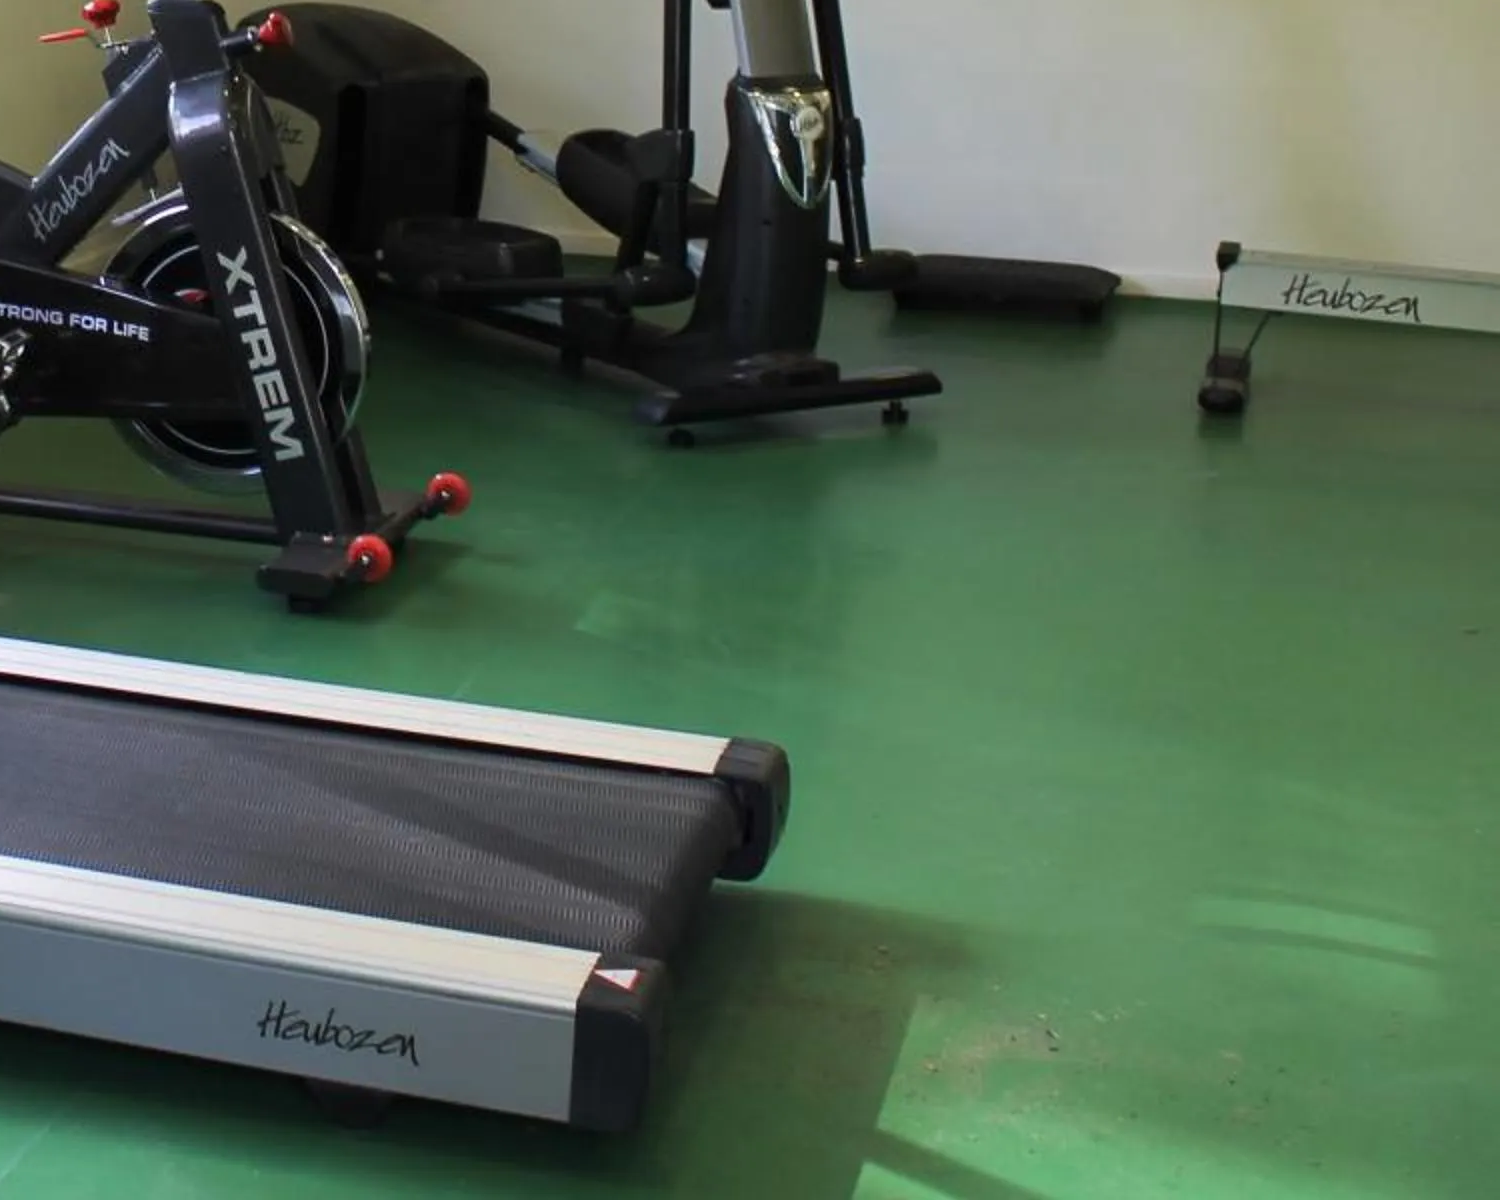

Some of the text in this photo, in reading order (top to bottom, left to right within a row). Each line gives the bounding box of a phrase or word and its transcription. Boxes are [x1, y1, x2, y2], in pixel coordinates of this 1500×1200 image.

[69, 312, 108, 333] FOR
[112, 320, 150, 342] LIFE
[215, 245, 305, 462] XTREM
